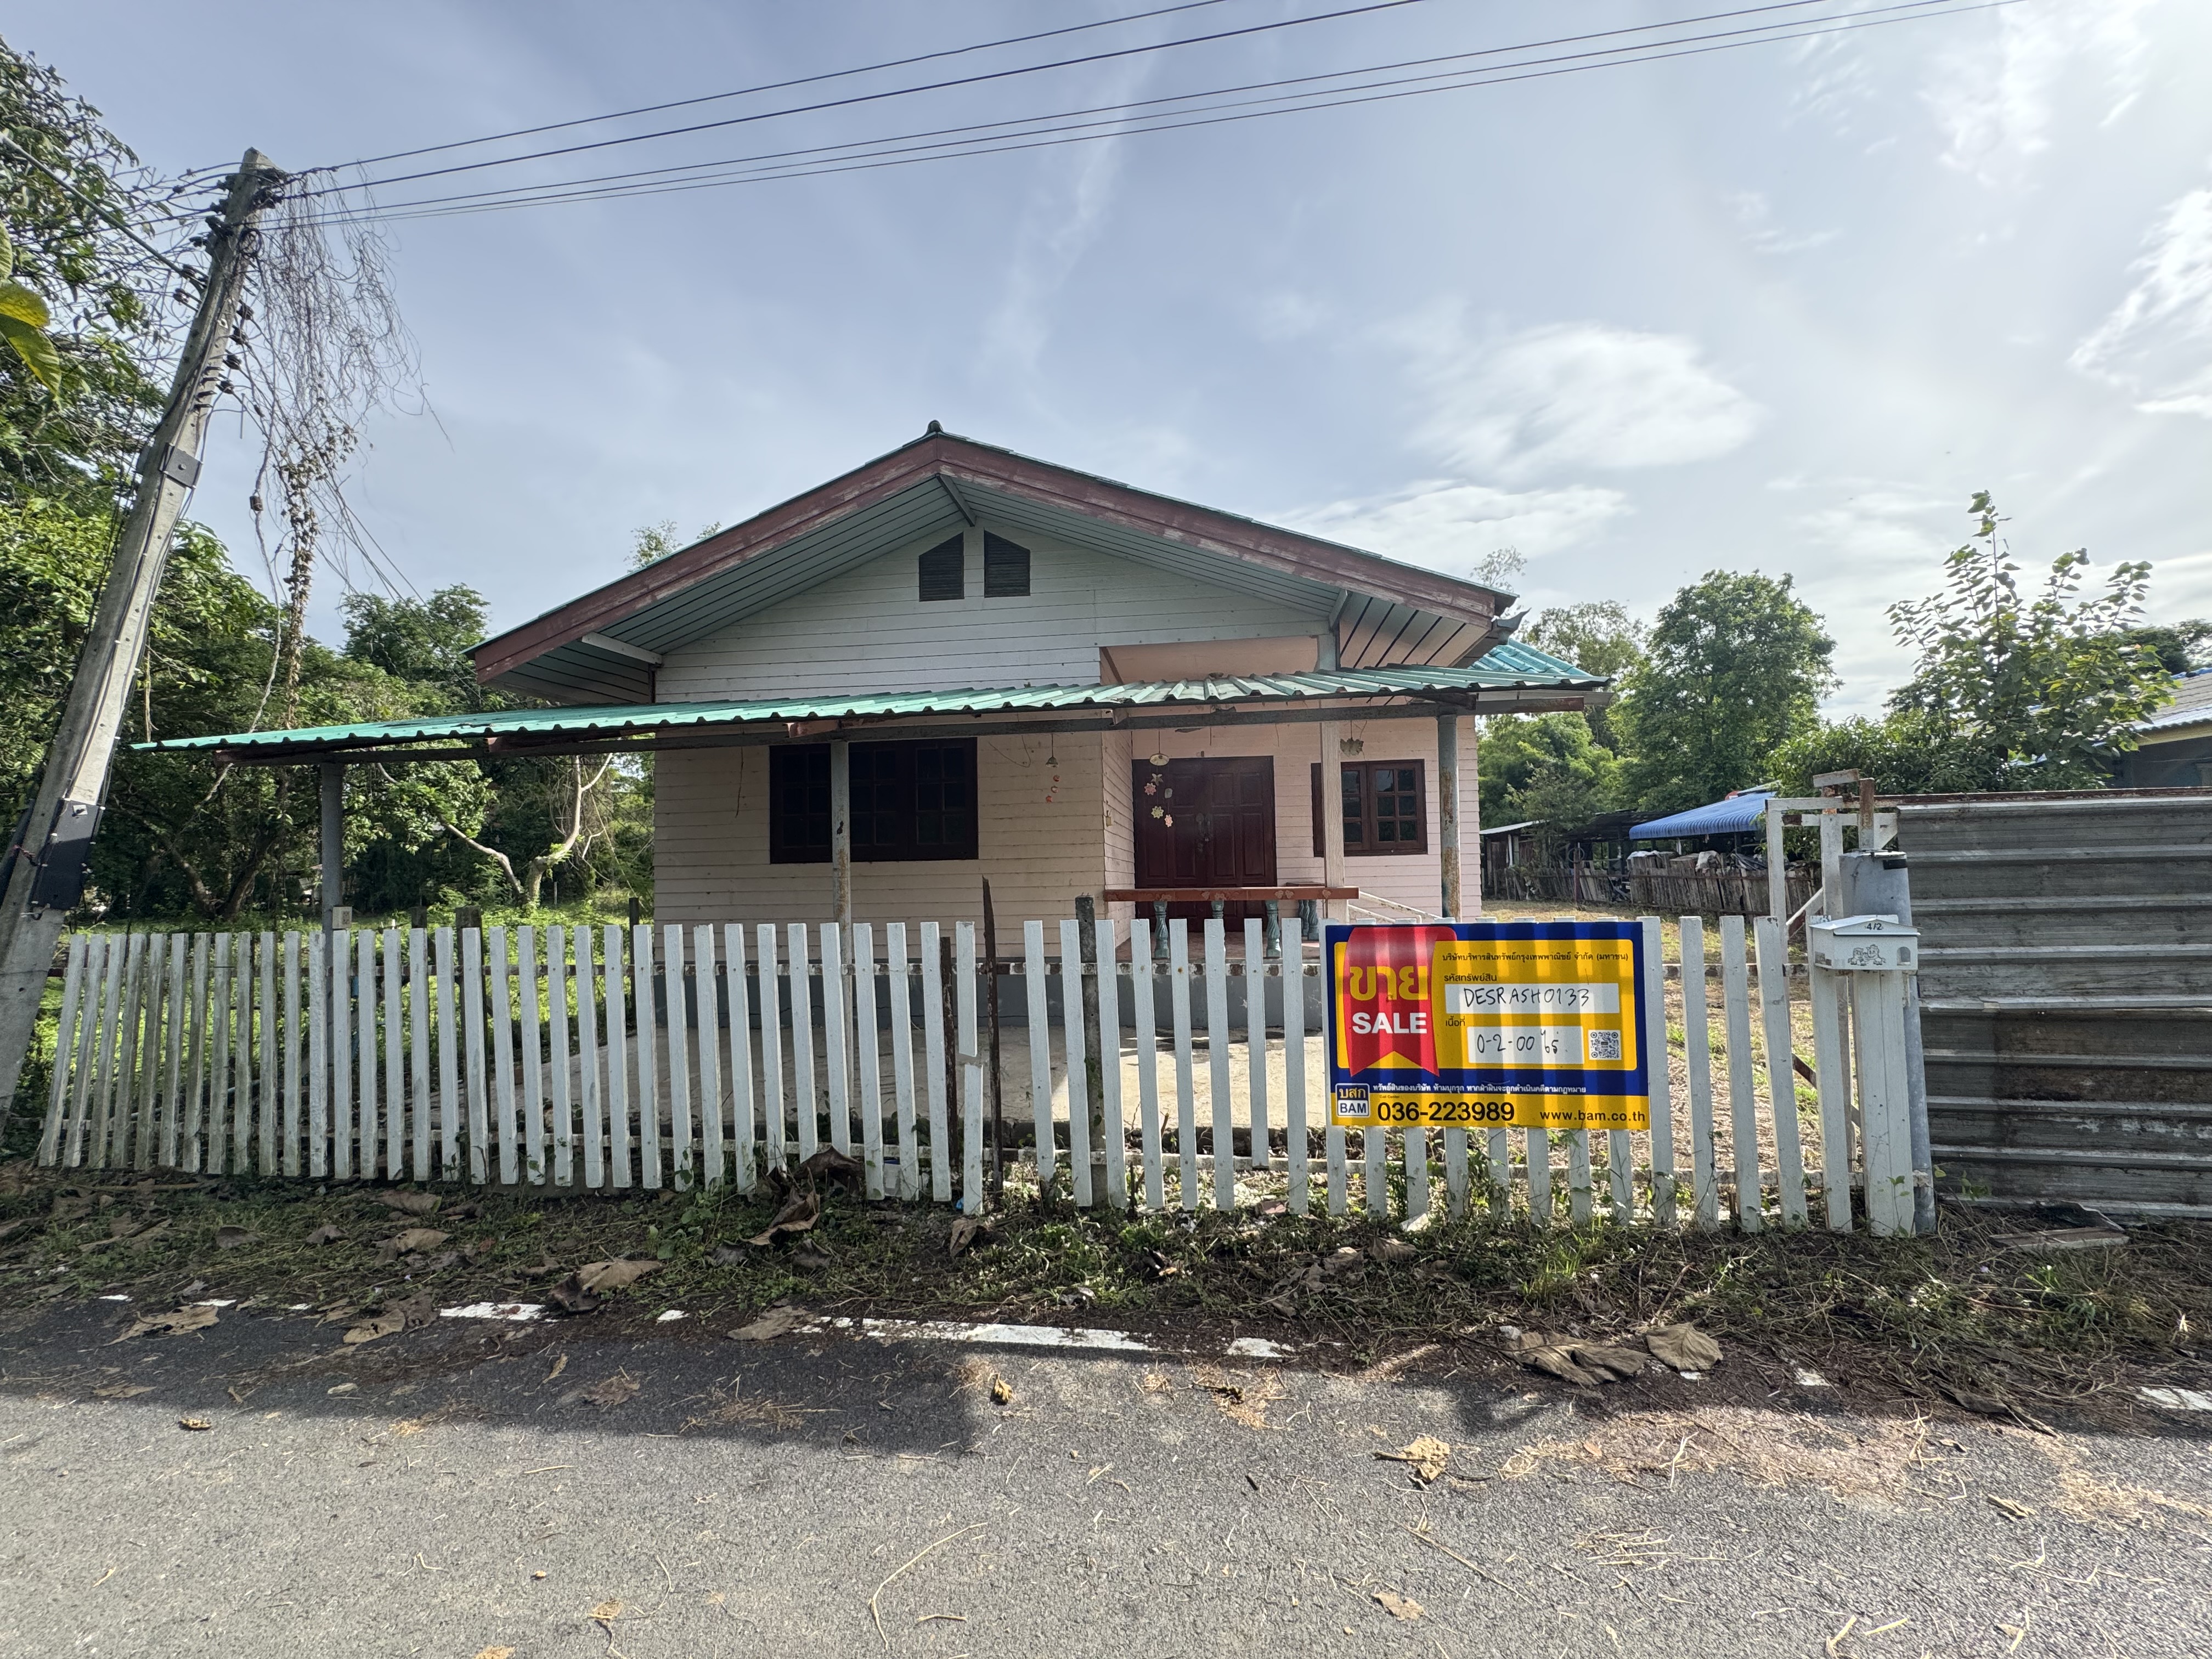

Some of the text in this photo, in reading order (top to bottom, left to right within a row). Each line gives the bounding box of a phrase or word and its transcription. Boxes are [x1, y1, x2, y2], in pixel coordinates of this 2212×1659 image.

[1596, 953, 1628, 961] (มหาชน)
[1350, 965, 1429, 1001] ขาย
[1444, 973, 1497, 982] รหัสทรัพย์สิน
[1352, 1013, 1428, 1034] SALE
[1446, 1015, 1465, 1026] เนื้อที่
[1373, 1082, 1431, 1092] ทรัพย์สินของบริษัท
[1339, 1087, 1366, 1099] บสก
[1340, 1103, 1367, 1113] BAM
[1378, 1102, 1515, 1121] 036-223989
[1540, 1110, 1646, 1122] www.bam.co.th
